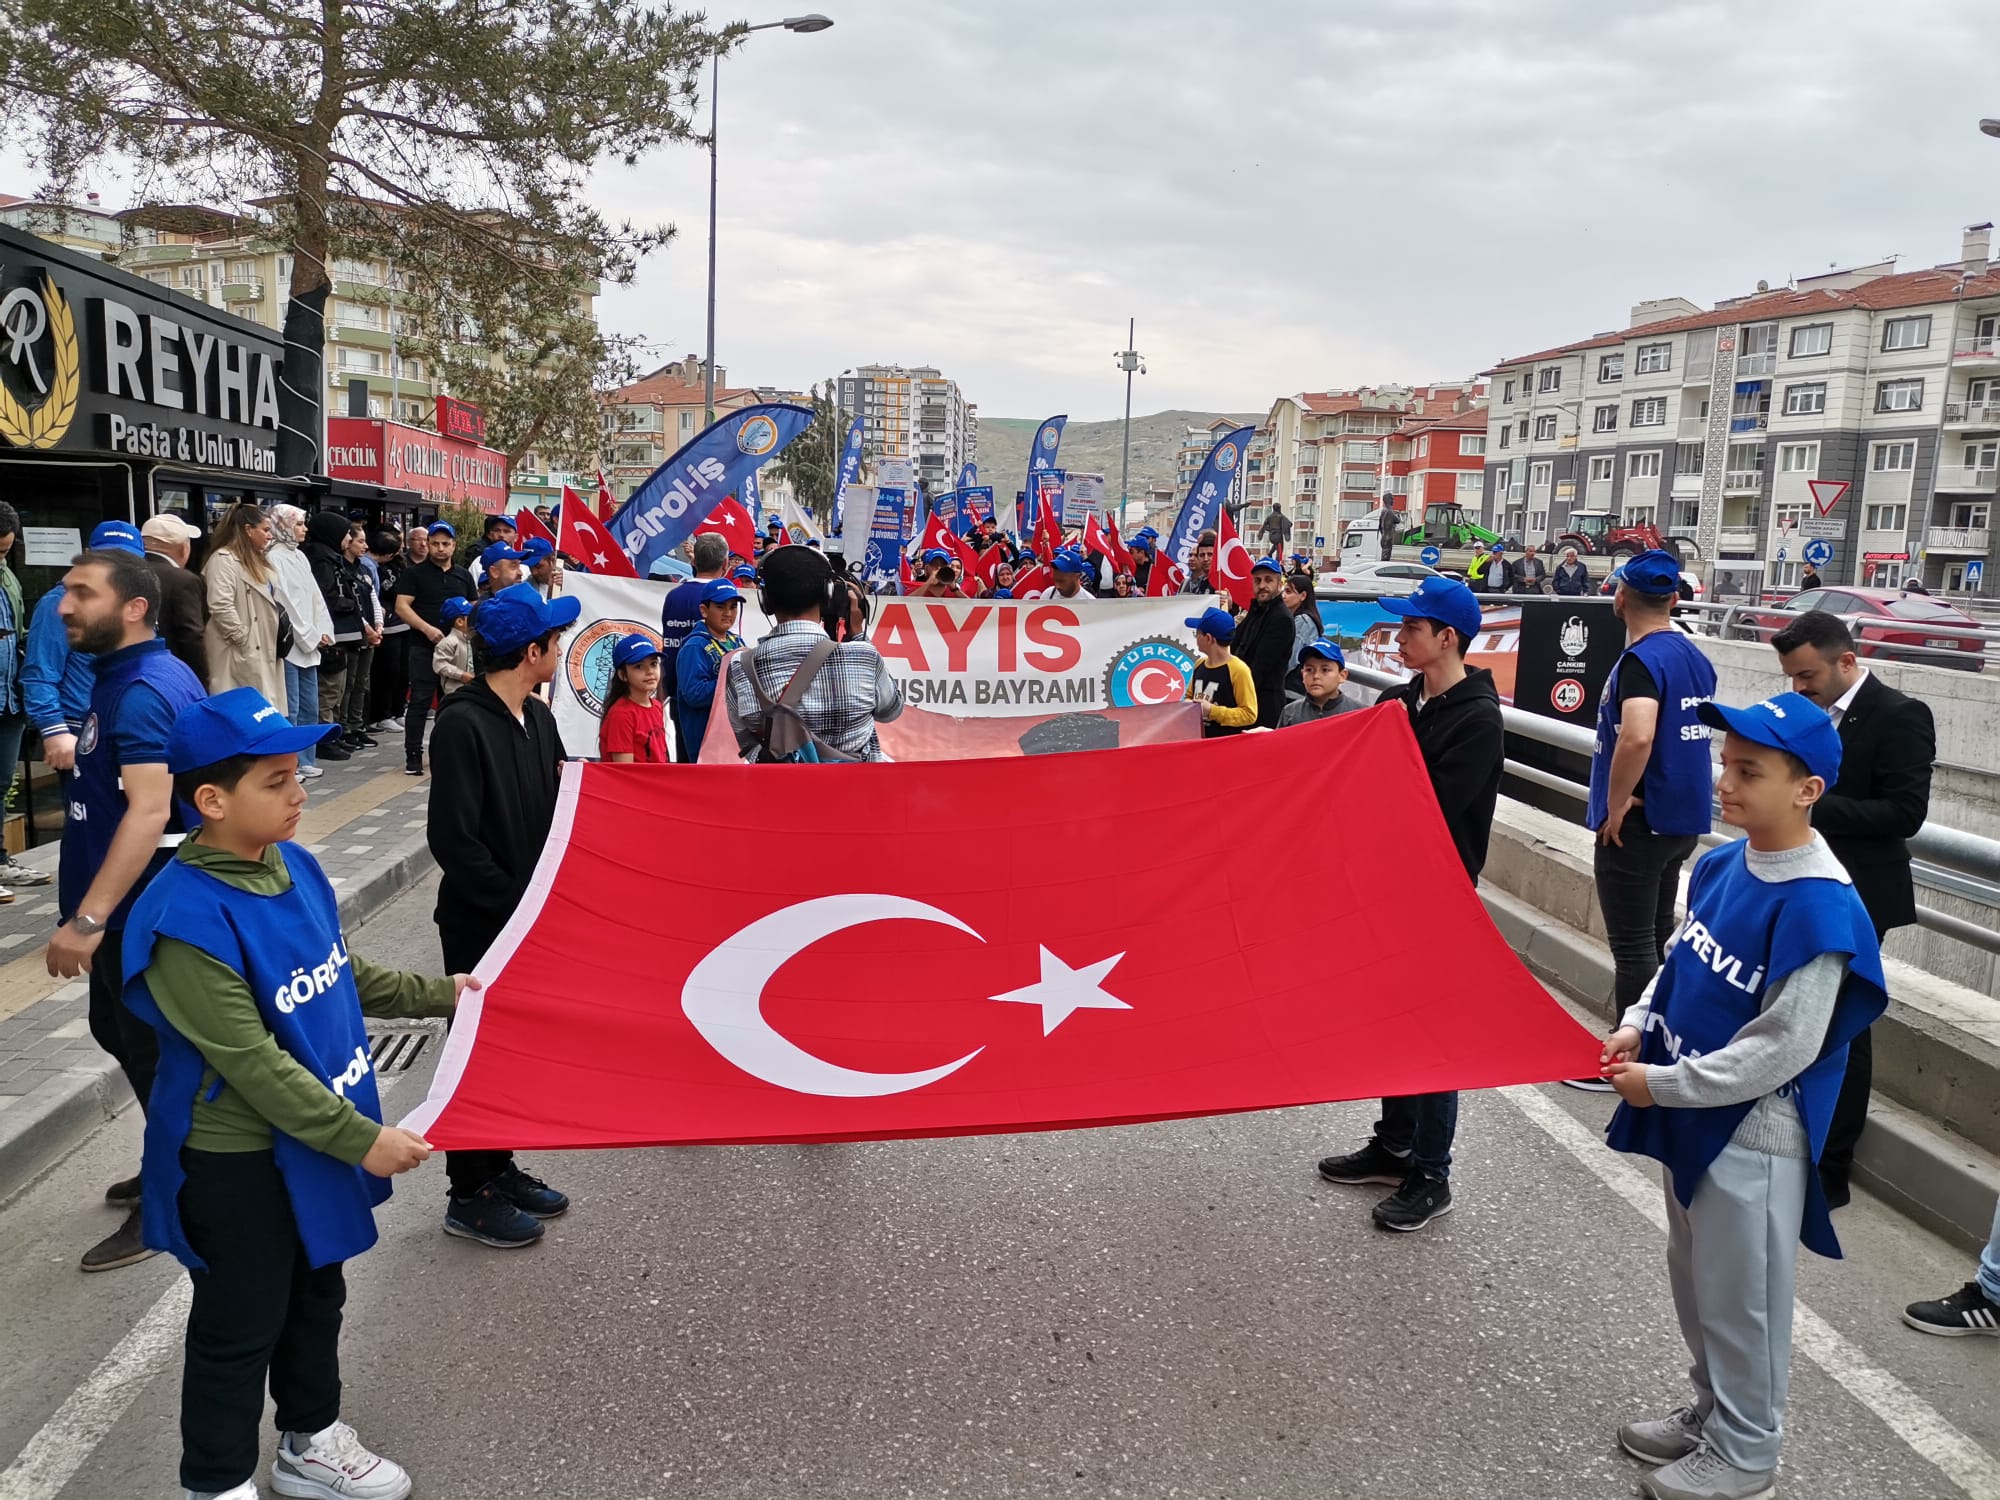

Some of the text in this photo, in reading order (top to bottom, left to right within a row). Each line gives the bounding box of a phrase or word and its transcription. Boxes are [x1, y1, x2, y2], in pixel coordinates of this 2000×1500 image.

[110, 414, 276, 473] Pasta & Unlu Mam
[404, 440, 448, 480] ORKİDE
[979, 677, 1095, 705] BAYRAMI
[1557, 688, 1567, 702] 4
